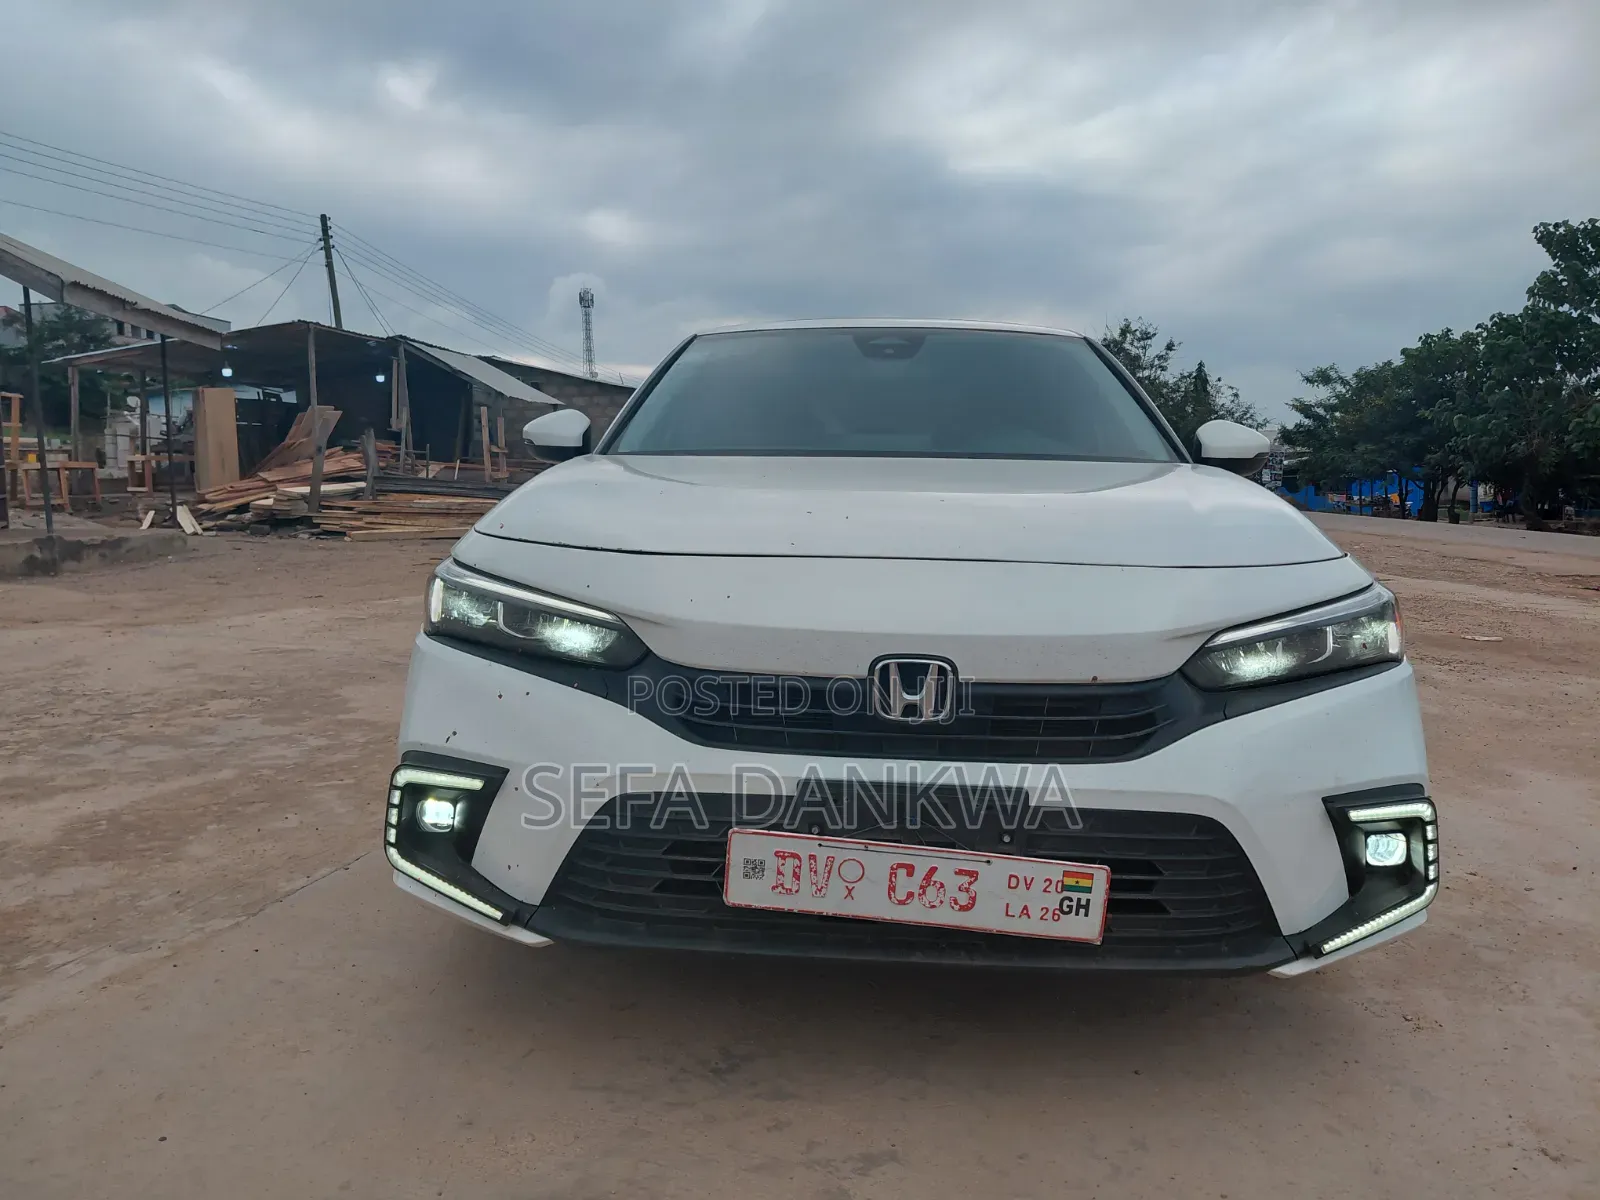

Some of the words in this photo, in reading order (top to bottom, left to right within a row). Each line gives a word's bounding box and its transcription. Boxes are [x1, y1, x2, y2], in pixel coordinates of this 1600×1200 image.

[771, 850, 836, 898] DV
[887, 862, 979, 912] C63
[1007, 874, 1035, 891] DV
[844, 885, 856, 900] X
[1005, 903, 1031, 920] LA
[1040, 906, 1061, 922] 26
[1059, 896, 1091, 918] GH
